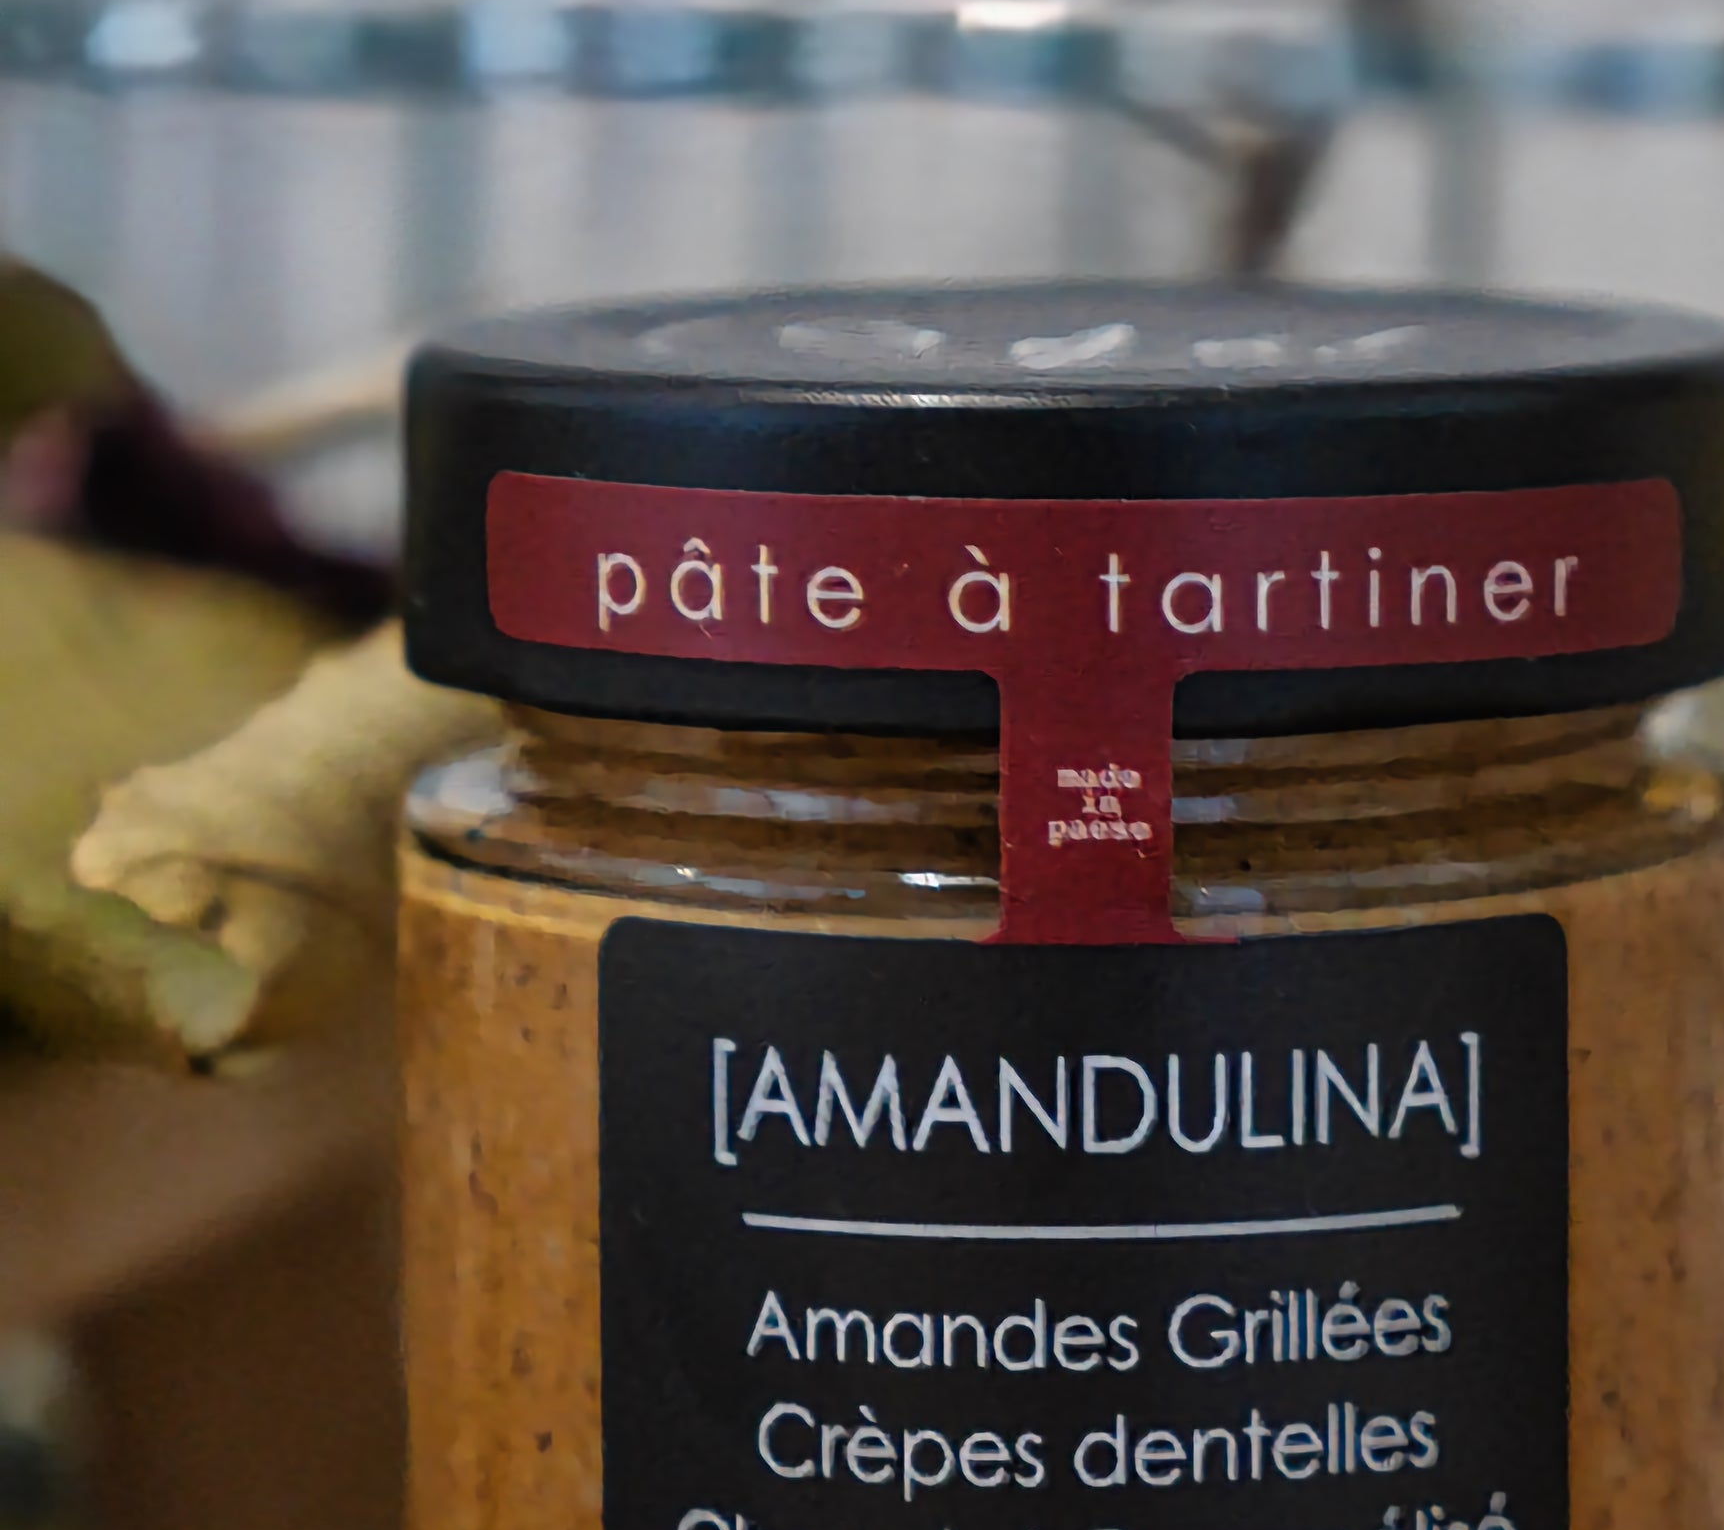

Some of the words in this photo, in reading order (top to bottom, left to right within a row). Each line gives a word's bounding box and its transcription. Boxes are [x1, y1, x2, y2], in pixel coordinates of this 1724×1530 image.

[597, 537, 864, 631] pâte
[947, 545, 1011, 633] à
[1099, 546, 1578, 634] tartiner
[713, 1031, 1481, 1166] [AMANDULINA]
[746, 1290, 1140, 1372] Amandes
[1168, 1280, 1452, 1368] Grillées
[758, 1402, 1045, 1502] Crèpes
[1073, 1402, 1439, 1488] dentelles
